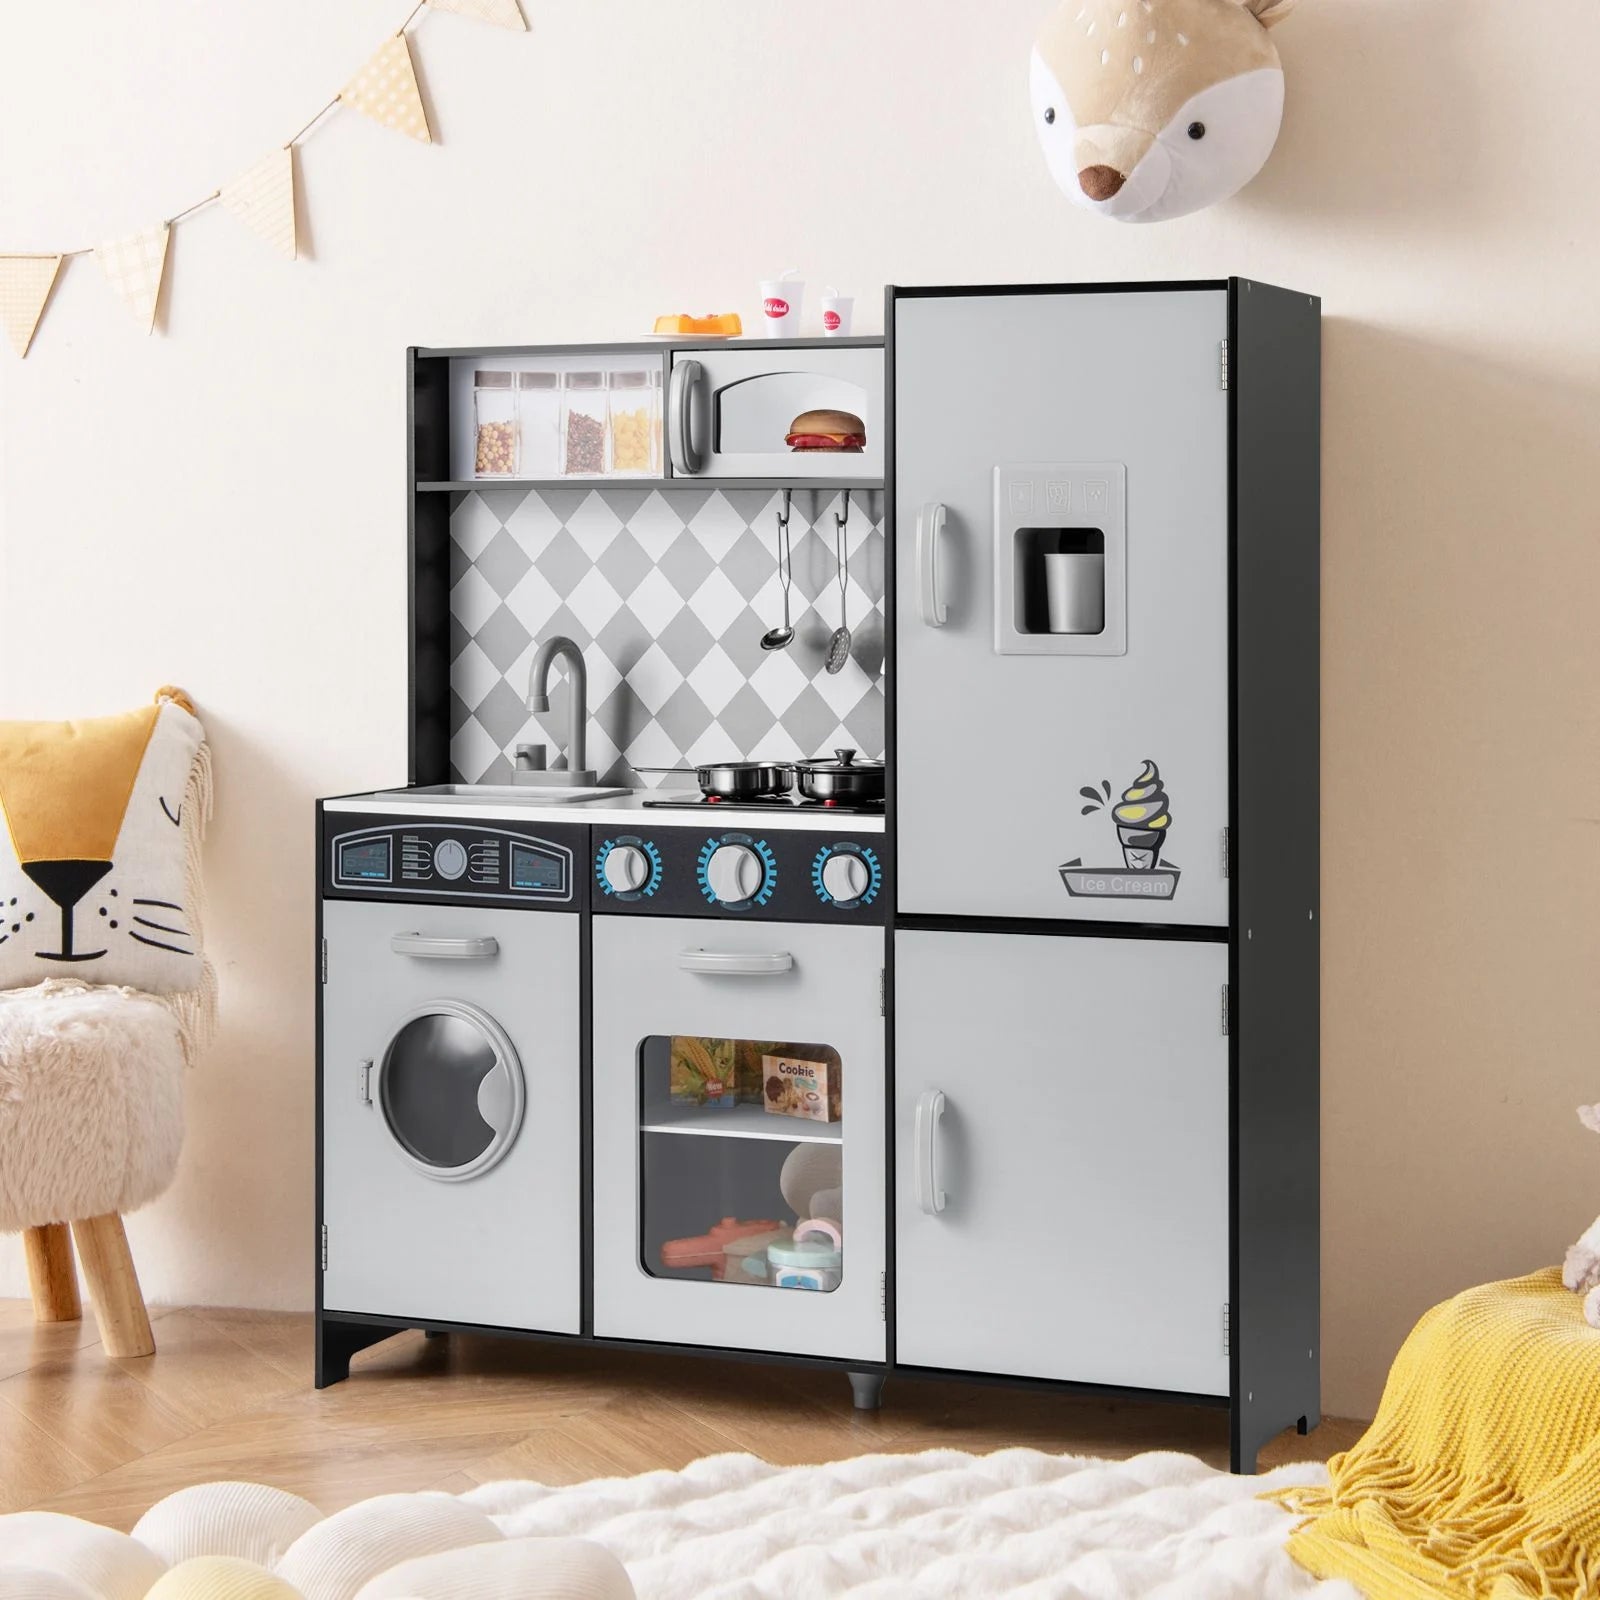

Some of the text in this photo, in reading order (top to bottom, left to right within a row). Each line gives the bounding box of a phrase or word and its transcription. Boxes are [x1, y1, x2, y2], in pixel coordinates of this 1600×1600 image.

[1080, 876, 1168, 894] Ice Cream
[779, 1062, 815, 1078] Cookie
